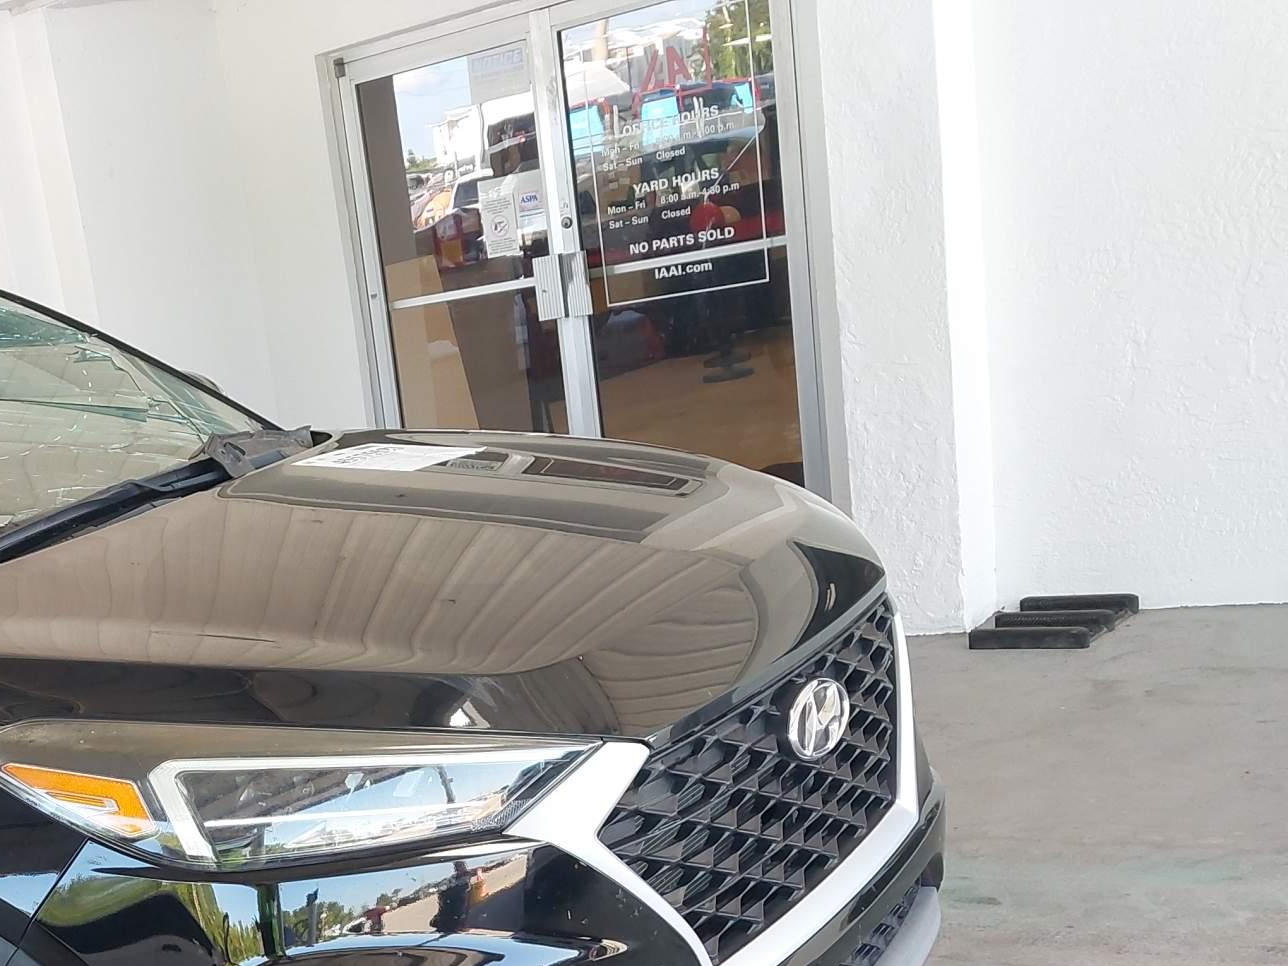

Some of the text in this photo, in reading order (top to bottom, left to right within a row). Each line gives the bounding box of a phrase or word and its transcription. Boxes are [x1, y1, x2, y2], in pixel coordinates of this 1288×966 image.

[626, 157, 643, 167] Sun
[656, 146, 686, 161] Closed
[633, 168, 720, 195] YARD HOURS
[607, 204, 627, 216] Mon
[635, 200, 646, 210] Fri
[609, 218, 624, 230] Sat
[632, 215, 649, 226] Sun
[661, 206, 691, 220] Closed
[629, 226, 735, 256] NO PARTS SOLD
[654, 262, 713, 280] IAAI.com
